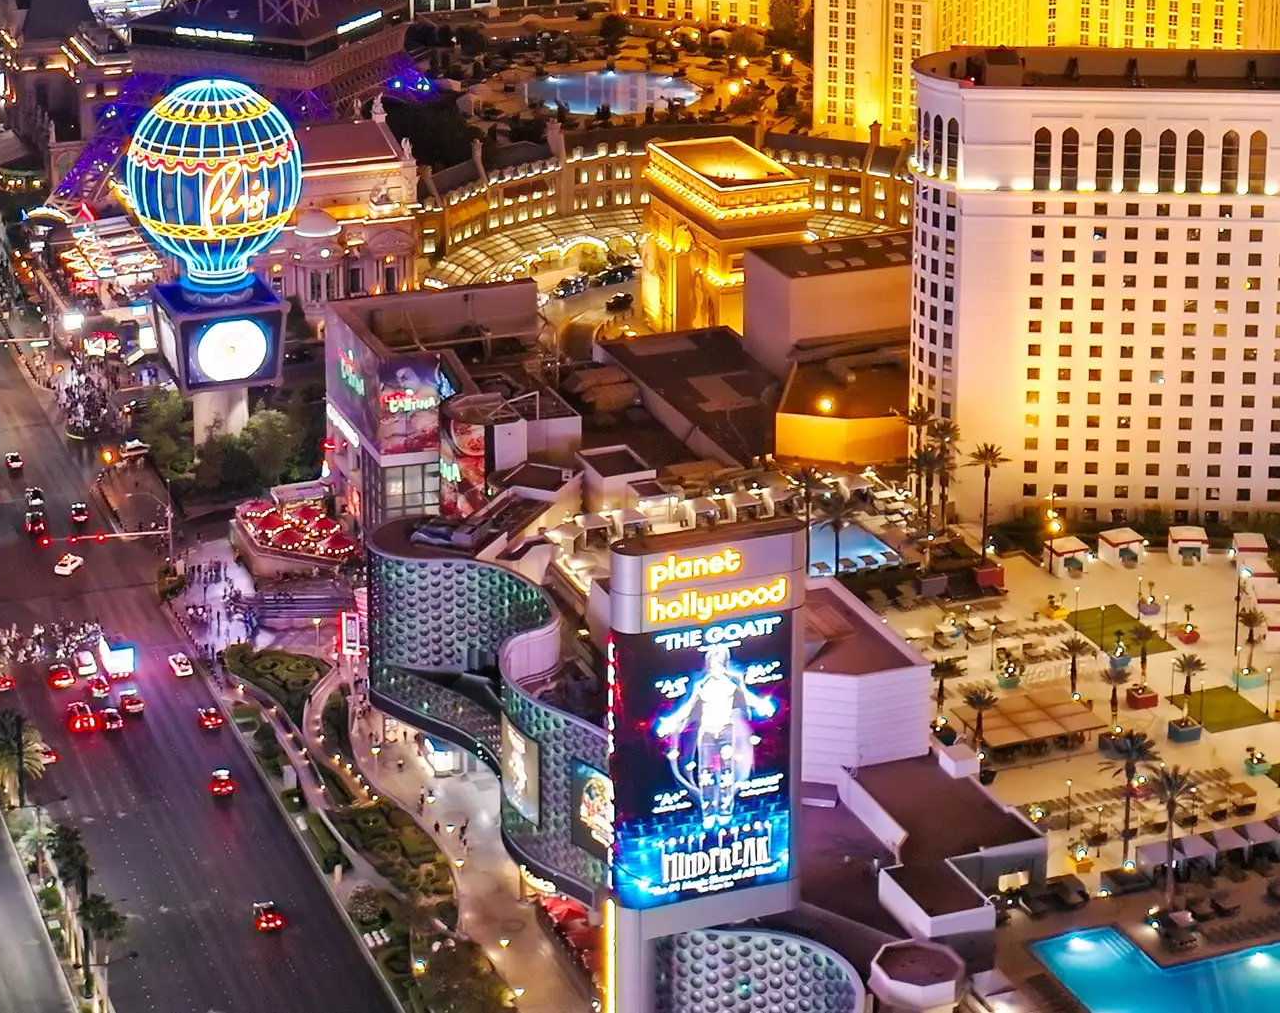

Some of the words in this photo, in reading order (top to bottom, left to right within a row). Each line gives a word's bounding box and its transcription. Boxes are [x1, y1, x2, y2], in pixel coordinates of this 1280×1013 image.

[204, 160, 271, 238] Paris
[650, 548, 741, 591] planet
[650, 577, 787, 622] hollywood
